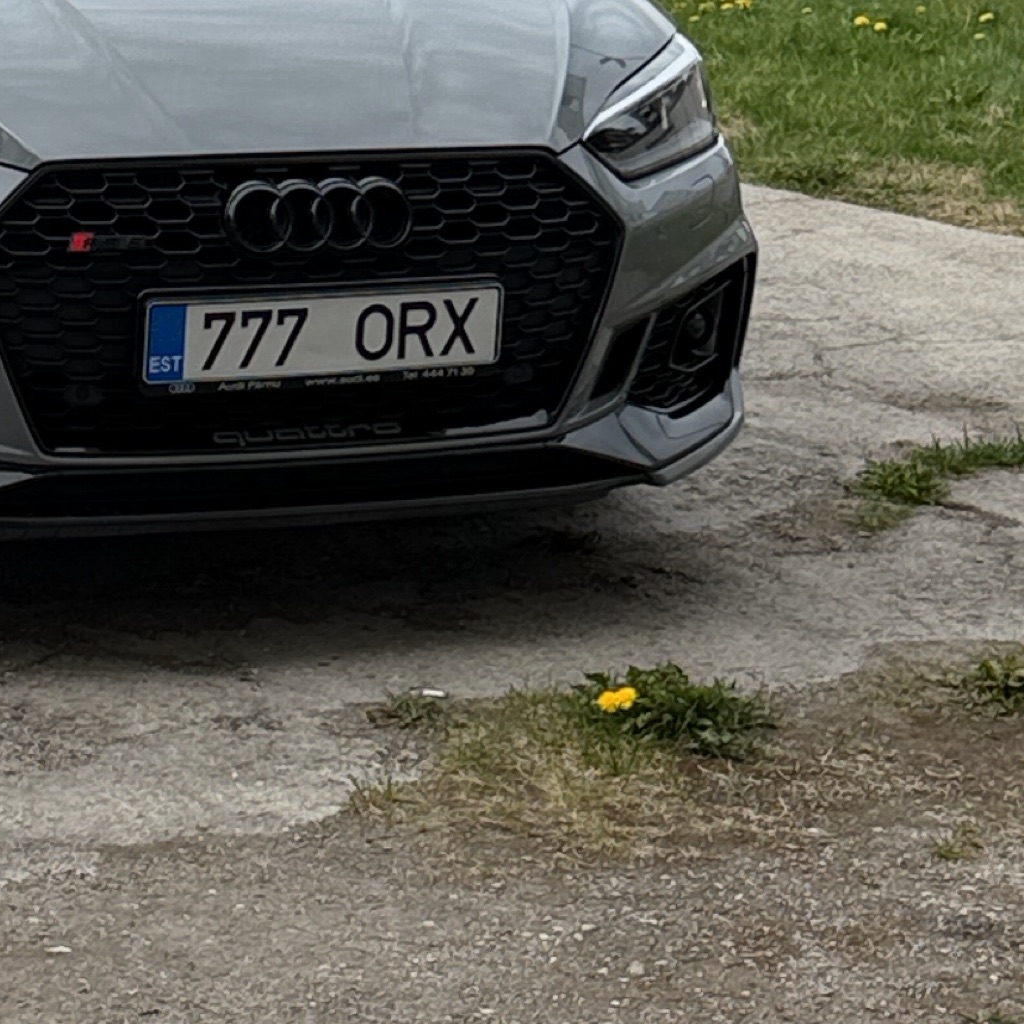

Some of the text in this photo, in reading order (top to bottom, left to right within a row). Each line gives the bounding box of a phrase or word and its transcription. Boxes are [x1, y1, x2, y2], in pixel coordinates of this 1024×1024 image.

[201, 297, 480, 371] 777 ORX
[148, 355, 183, 374] EST
[217, 381, 245, 391] Audi
[212, 422, 402, 447] quattro
